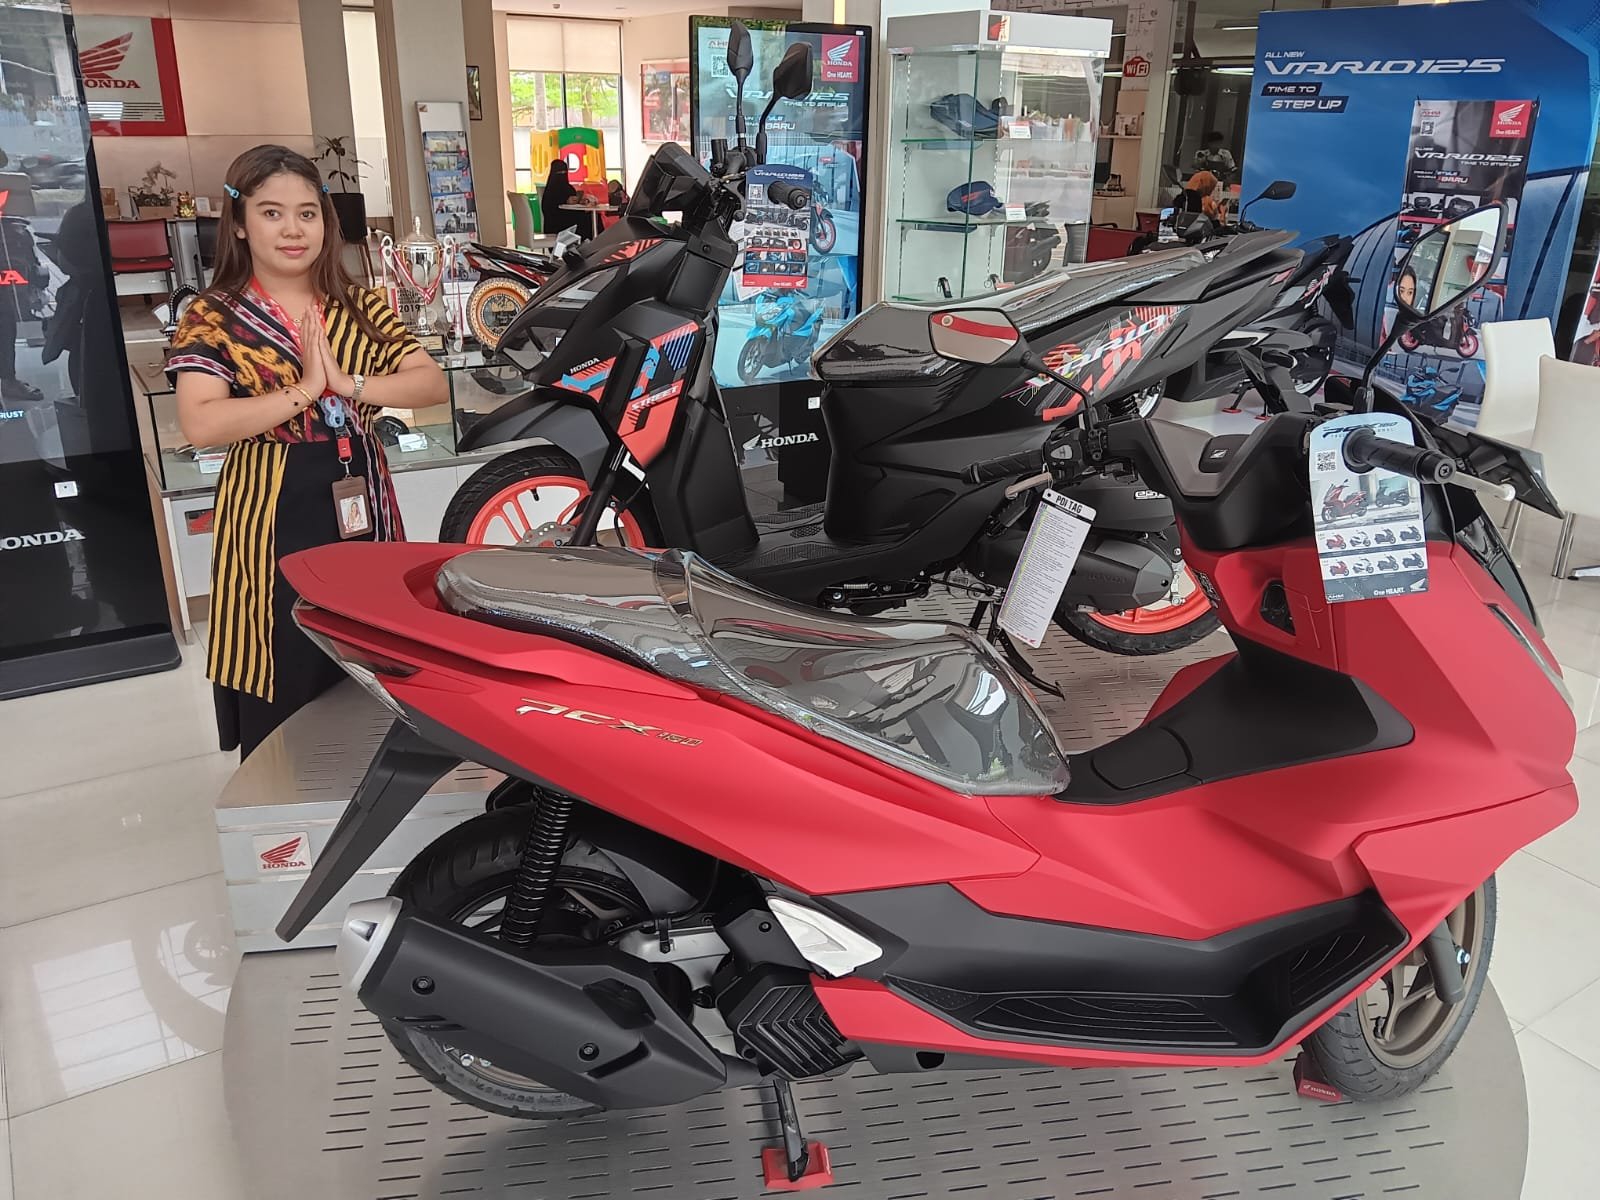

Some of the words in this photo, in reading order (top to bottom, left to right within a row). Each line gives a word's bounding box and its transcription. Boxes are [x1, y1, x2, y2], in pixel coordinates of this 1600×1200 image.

[1265, 51, 1282, 59] ALL
[84, 79, 141, 89] ONDA
[1271, 99, 1315, 110] STEP
[1317, 99, 1343, 110] UP
[398, 304, 421, 313] 2019
[569, 357, 601, 375] HONDA
[631, 384, 679, 411] STREET
[760, 432, 819, 450] HONDA
[1056, 495, 1068, 507] PDI
[1068, 500, 1083, 514] TAG
[0, 528, 87, 552] ONDA
[262, 861, 306, 869] HONDA
